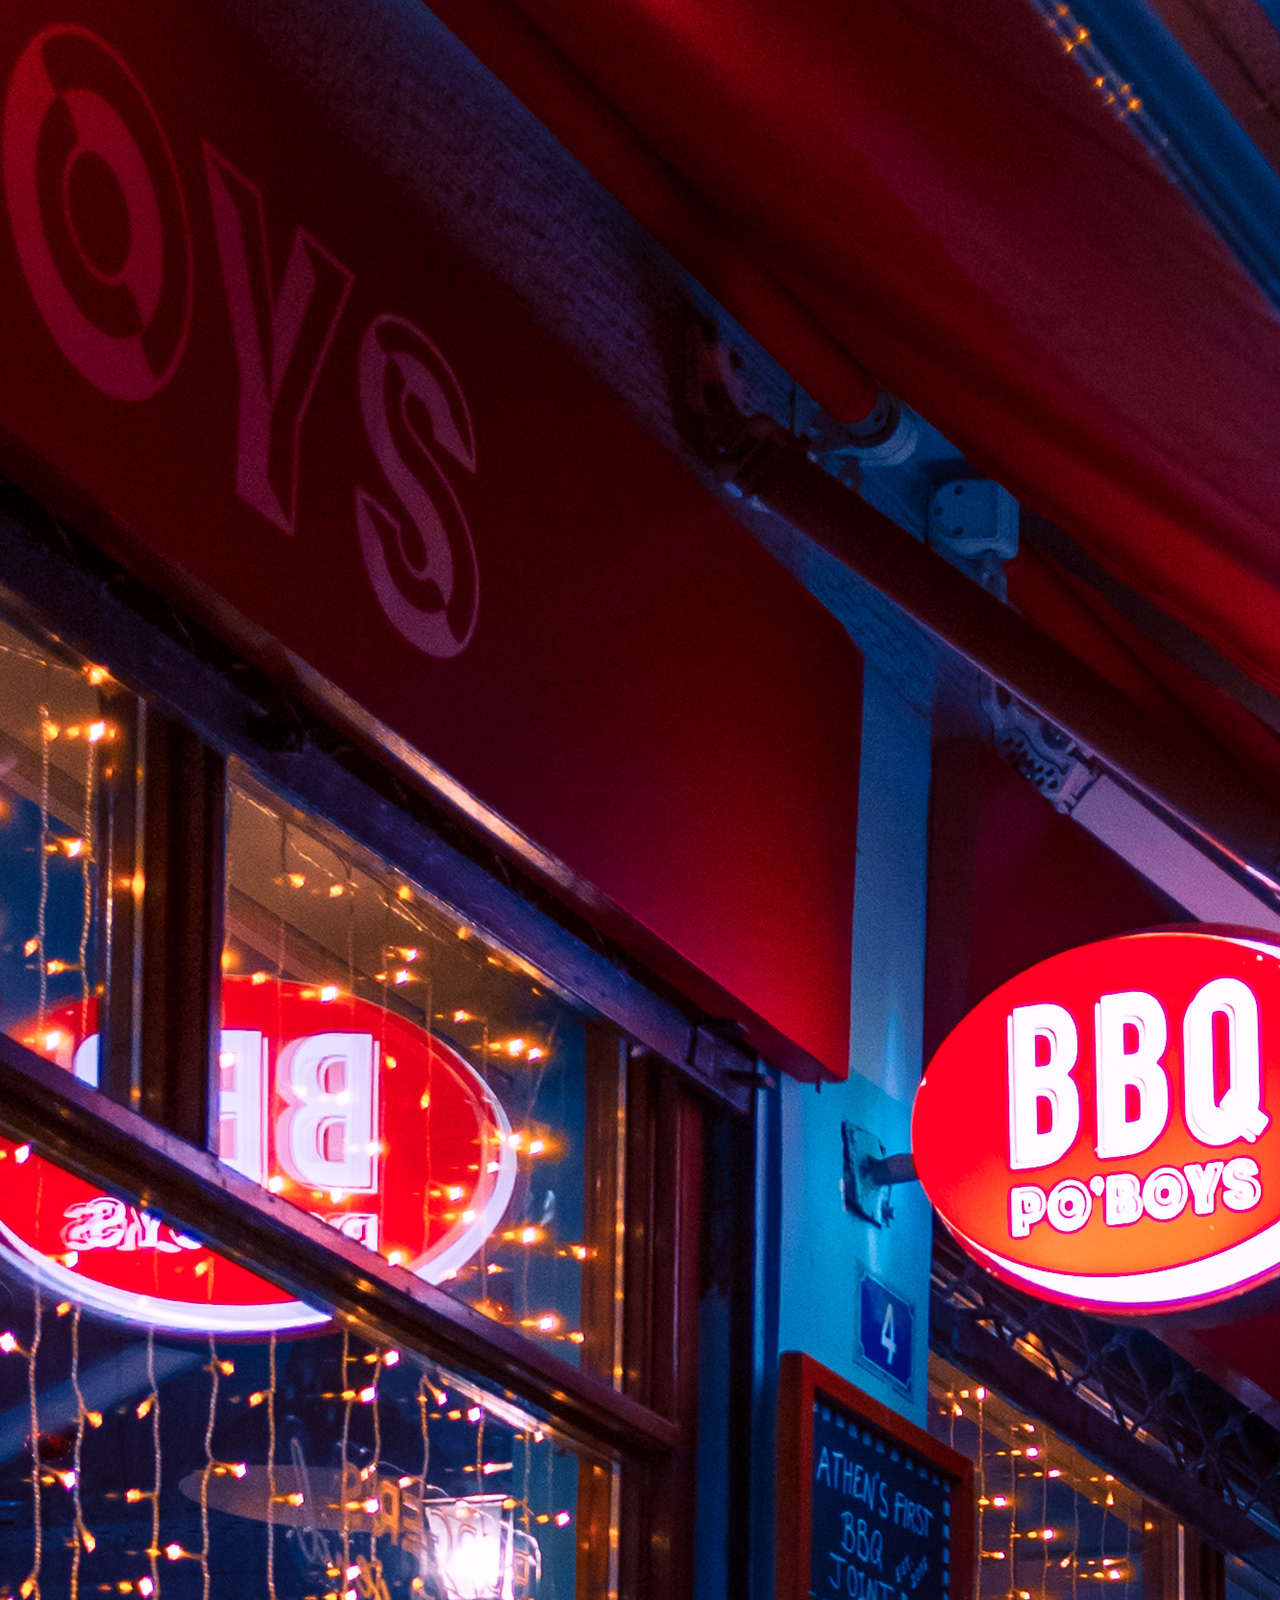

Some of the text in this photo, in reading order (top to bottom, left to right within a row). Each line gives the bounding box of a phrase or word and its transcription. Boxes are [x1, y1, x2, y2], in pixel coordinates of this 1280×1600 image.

[1007, 977, 1270, 1171] BBQ
[1009, 1156, 1264, 1239] PO'BOYS
[881, 1303, 896, 1365] 4
[816, 1446, 934, 1537] ATHEN'S FIRST
[841, 1510, 883, 1571] BBQ
